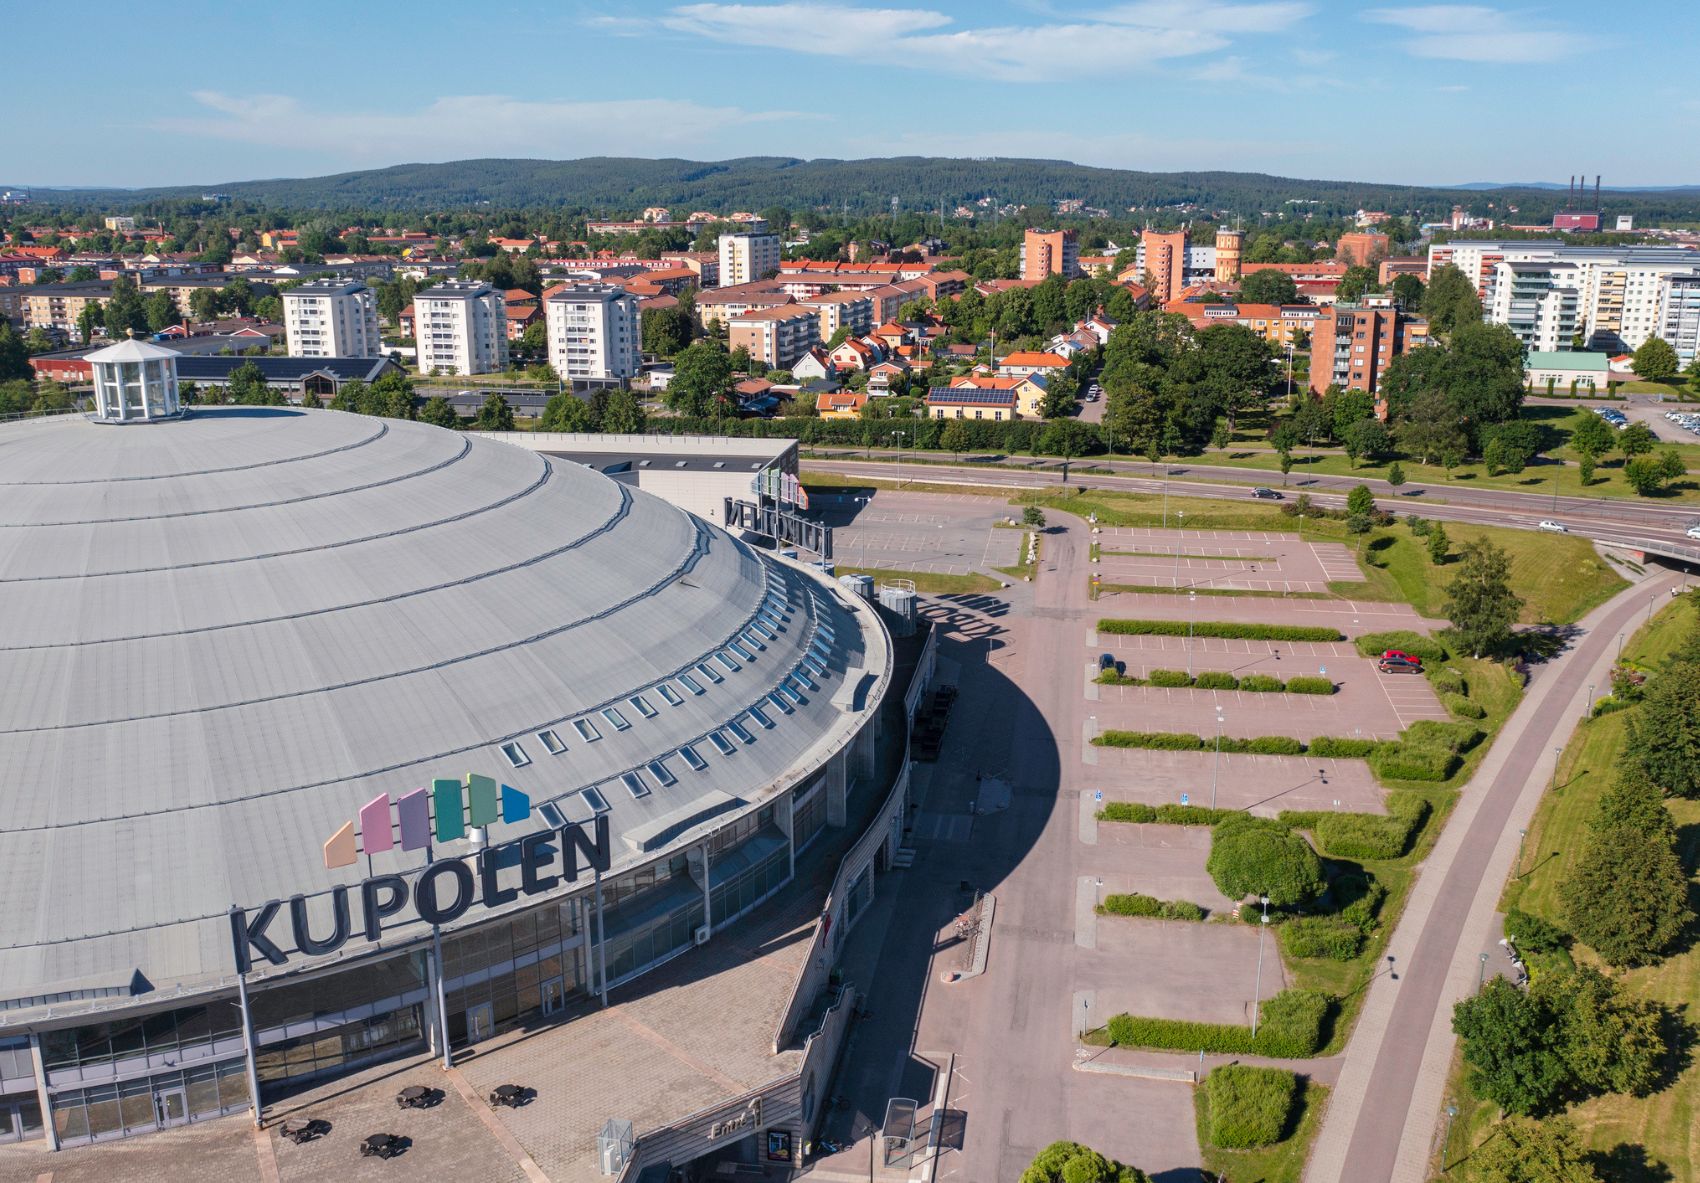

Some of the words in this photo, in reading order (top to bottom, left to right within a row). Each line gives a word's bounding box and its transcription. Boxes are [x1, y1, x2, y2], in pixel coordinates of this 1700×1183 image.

[230, 814, 610, 974] KUPOLEN
[710, 1113, 746, 1139] Entré
[749, 1097, 762, 1130] 1
